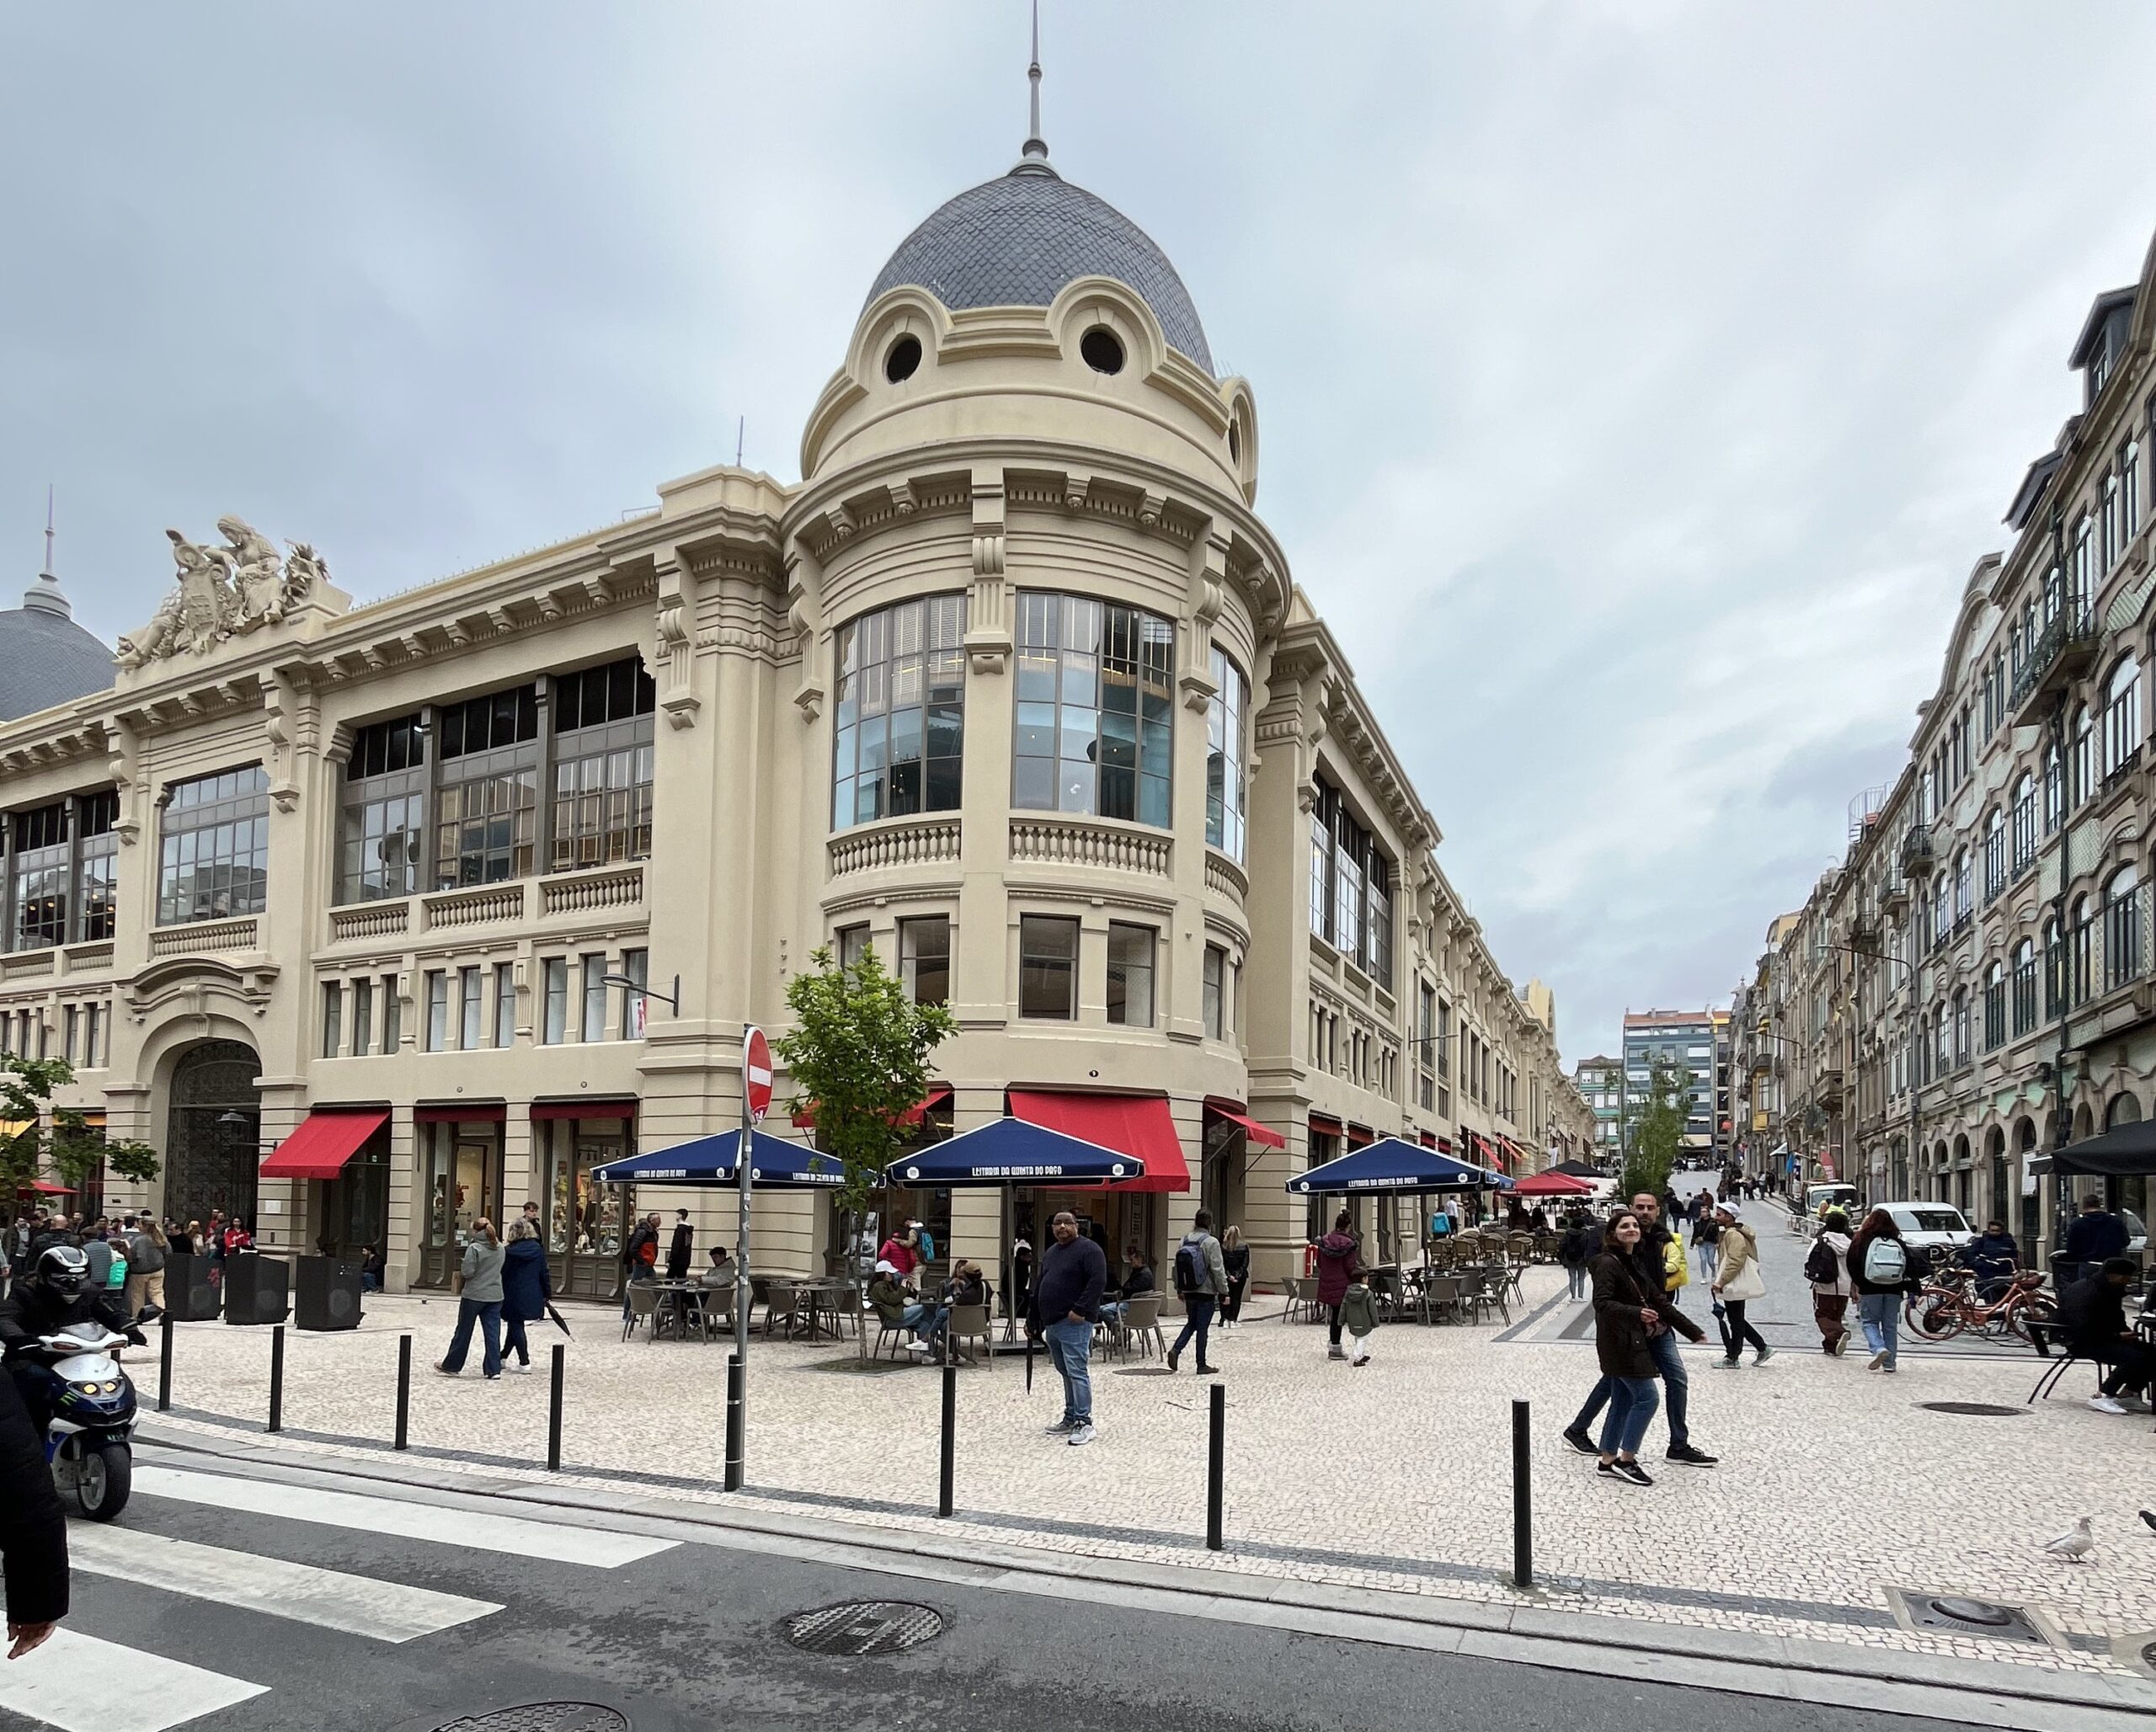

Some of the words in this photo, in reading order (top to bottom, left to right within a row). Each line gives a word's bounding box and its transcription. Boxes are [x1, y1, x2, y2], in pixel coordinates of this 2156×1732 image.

[972, 1167, 1000, 1176] LEITARIA
[1001, 1166, 1011, 1175] DA
[1011, 1166, 1034, 1175] QUINTA
[1035, 1165, 1044, 1175] DO
[1045, 1165, 1062, 1175] PAÇO
